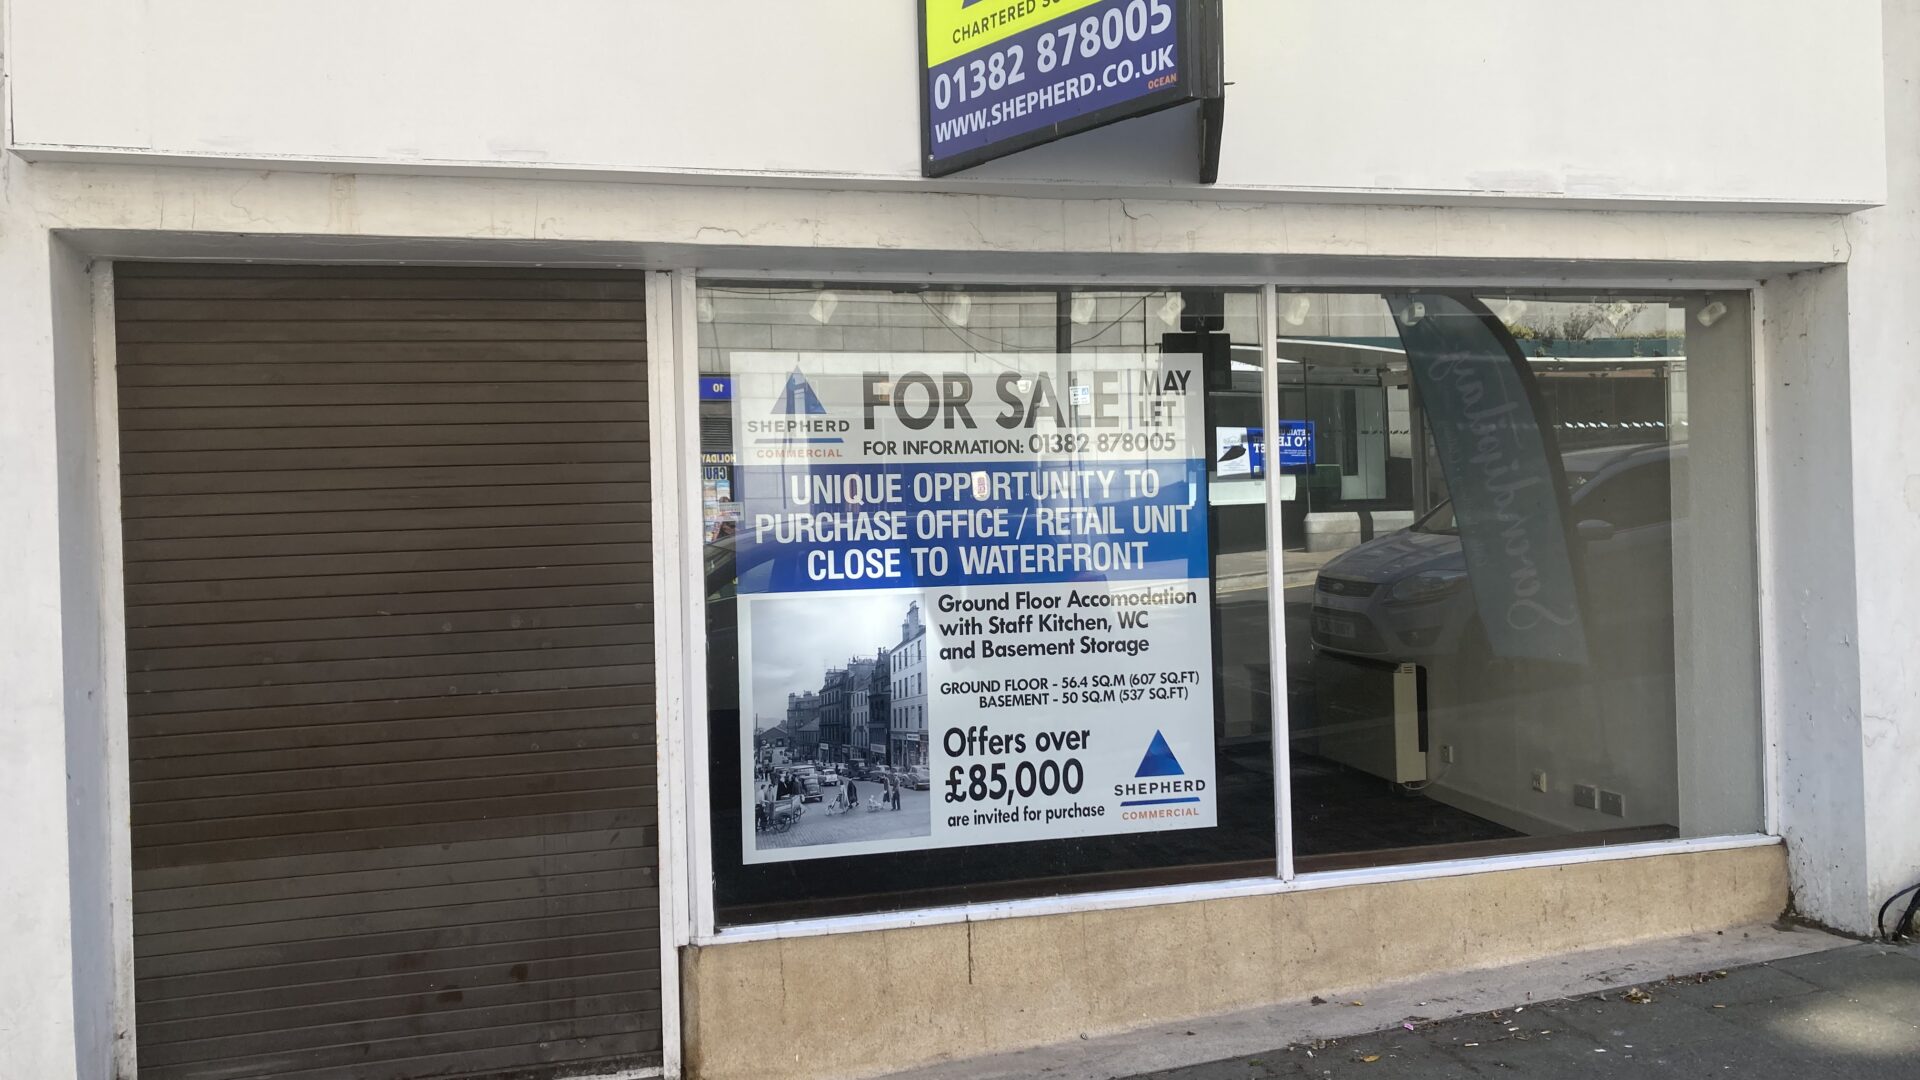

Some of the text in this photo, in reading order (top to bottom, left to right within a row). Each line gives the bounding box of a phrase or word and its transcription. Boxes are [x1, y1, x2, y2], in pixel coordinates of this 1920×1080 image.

[952, 0, 1036, 44] CHARTERED
[934, 0, 1172, 110] 01382 878005
[935, 44, 1175, 143] WWW.SHEPHERD.CO.UK
[1147, 73, 1178, 90] OCEAN
[1138, 370, 1192, 396] MAY
[862, 370, 1120, 430] FOR SALE
[747, 420, 851, 433] SHEPHERD
[1138, 401, 1177, 427] LET
[756, 448, 844, 458] COMMERCIAL
[862, 432, 1177, 456] FOR INFORMATION: 01382 878005
[790, 469, 1160, 506] UNIQUE OPPORTUNITY TO
[754, 510, 908, 544] PURCHASE
[916, 508, 1009, 540] OFFICE
[1015, 507, 1029, 540] /
[1035, 506, 1125, 537] RETAIL
[1132, 503, 1193, 534] UNIT
[807, 541, 1149, 581] CLOSE TO WATERFRONT
[938, 586, 1197, 613] Ground Floor Accomodation
[939, 610, 1149, 637] with Staff Kitchen, WC
[939, 635, 1150, 660] and Basement Storage
[940, 680, 1001, 695] GROUND
[1005, 677, 1049, 692] FLOOR
[1061, 675, 1088, 689] 56.4
[1092, 673, 1126, 689] SQ.M
[1129, 672, 1155, 688] (607
[1160, 671, 1200, 687] SQ.FT)
[979, 692, 1050, 708] BASEMENT
[1062, 691, 1079, 705] 50
[1082, 688, 1116, 704] SQ.M
[1119, 688, 1144, 703] (537
[1149, 686, 1189, 701] SQ.FT)
[943, 725, 1091, 758] Offers over
[944, 757, 1085, 806] £85,000
[1114, 779, 1206, 797] SHEPHERD
[947, 802, 1106, 827] are invited for purchase
[1121, 807, 1200, 821] COMMERCIAL
